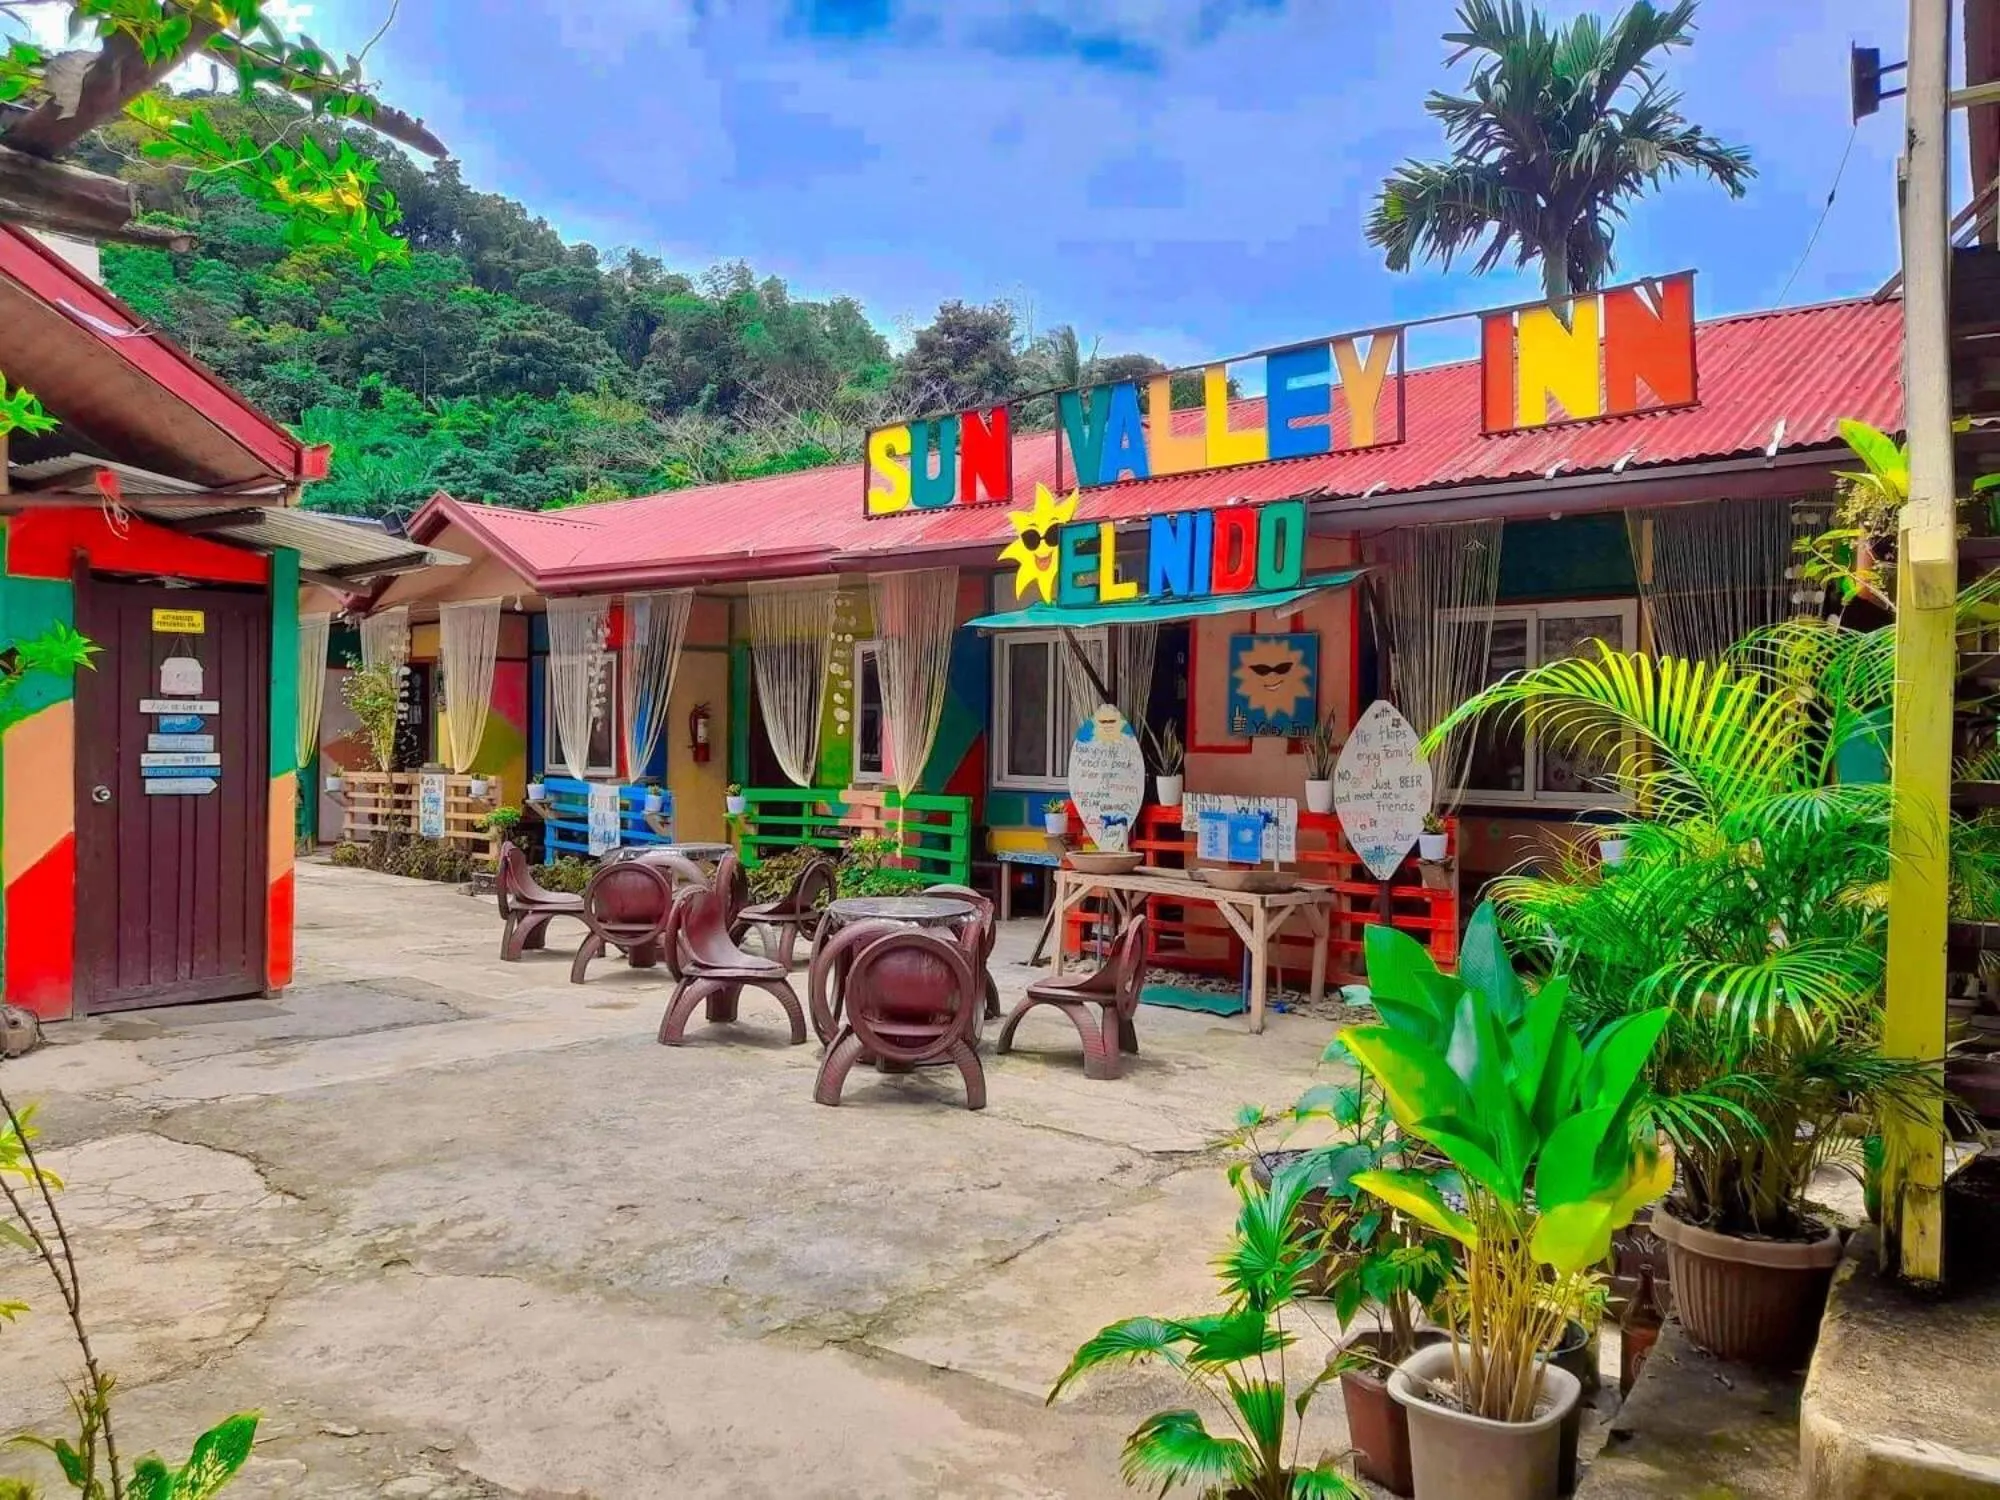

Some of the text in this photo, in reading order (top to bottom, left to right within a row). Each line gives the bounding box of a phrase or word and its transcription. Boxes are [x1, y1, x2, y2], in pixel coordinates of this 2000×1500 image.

[868, 272, 1697, 514] SUN VALLEY INN
[1056, 499, 1306, 607] EL NIDO
[1337, 768, 1351, 783] NO
[1399, 774, 1423, 788] BEER
